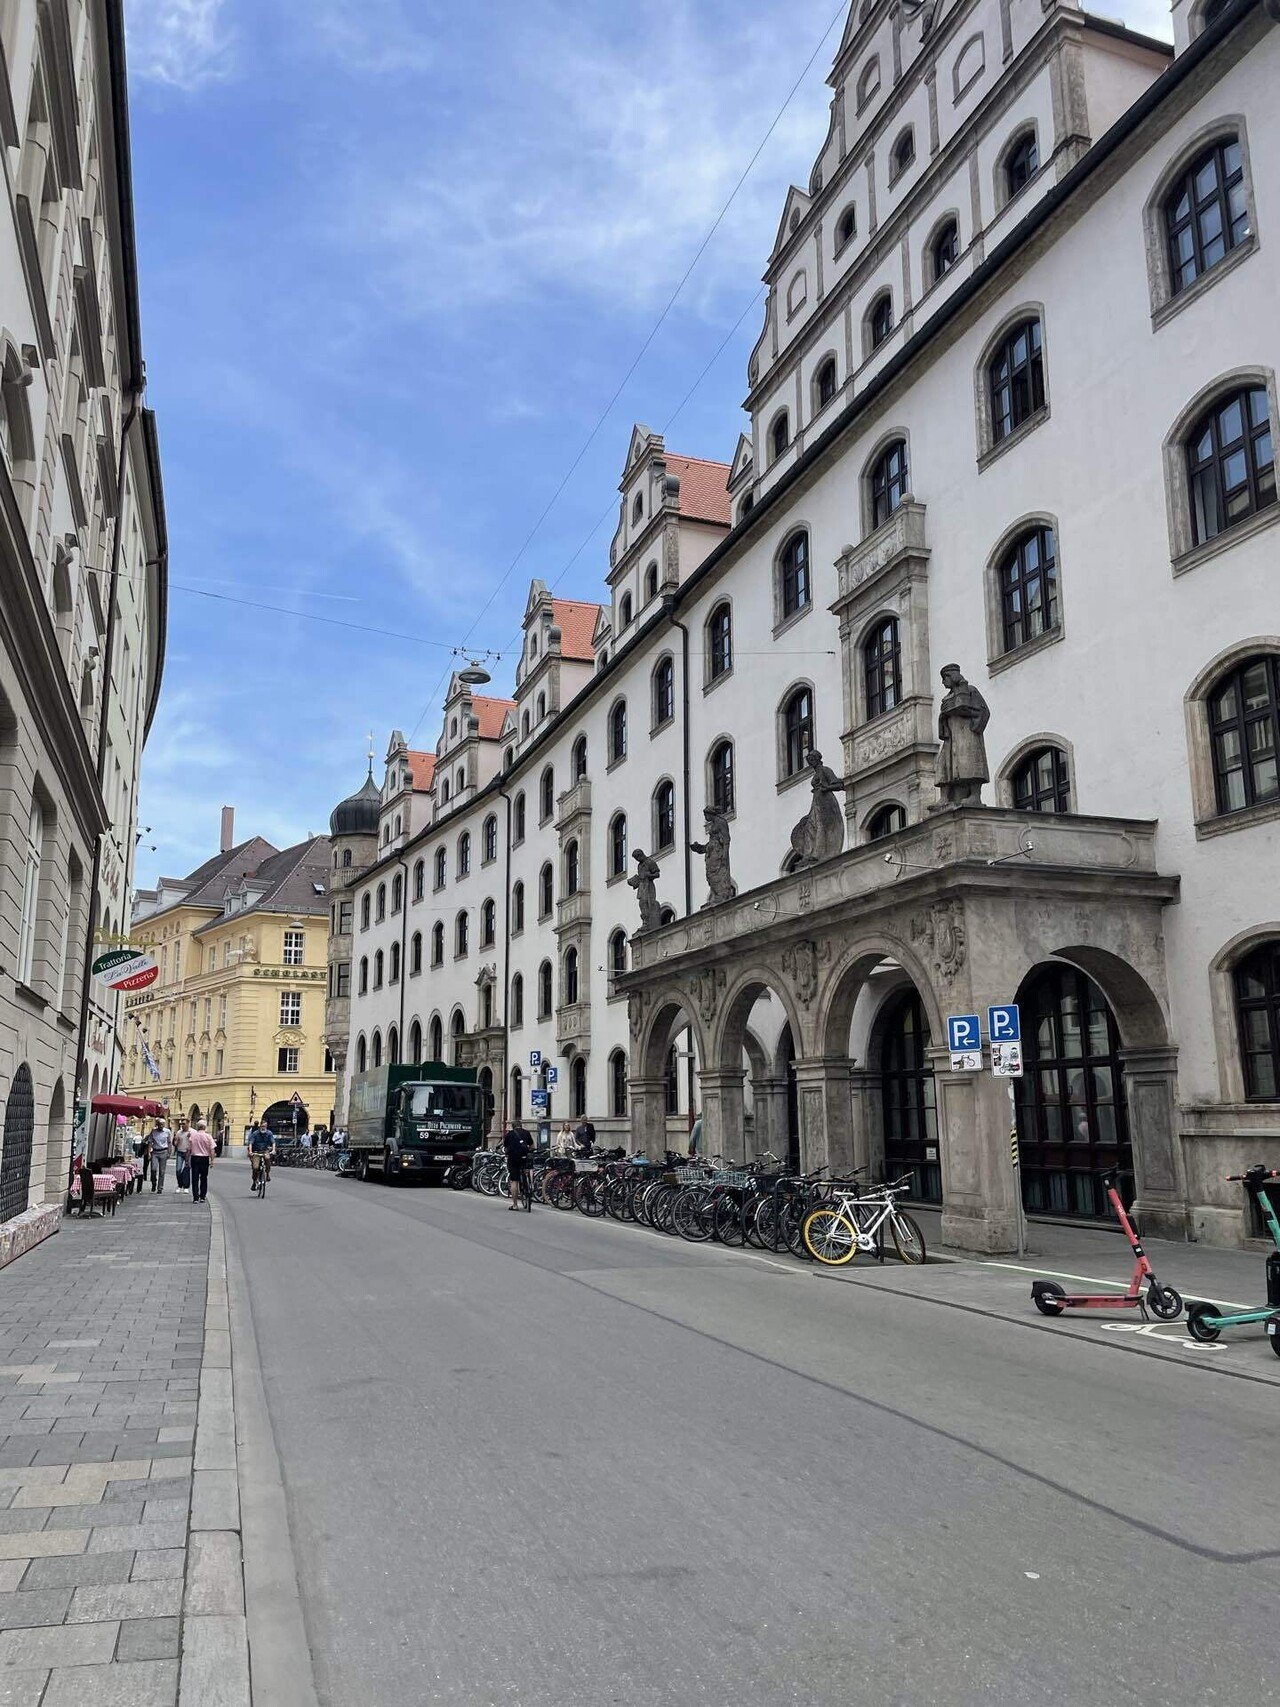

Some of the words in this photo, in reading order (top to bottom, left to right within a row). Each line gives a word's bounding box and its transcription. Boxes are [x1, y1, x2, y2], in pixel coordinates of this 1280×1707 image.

[98, 953, 132, 970] Trattoria
[123, 971, 154, 988] Pizzeria
[993, 1010, 1010, 1037] P
[953, 1020, 970, 1047] P
[531, 1052, 538, 1065] P
[548, 1069, 555, 1082] P
